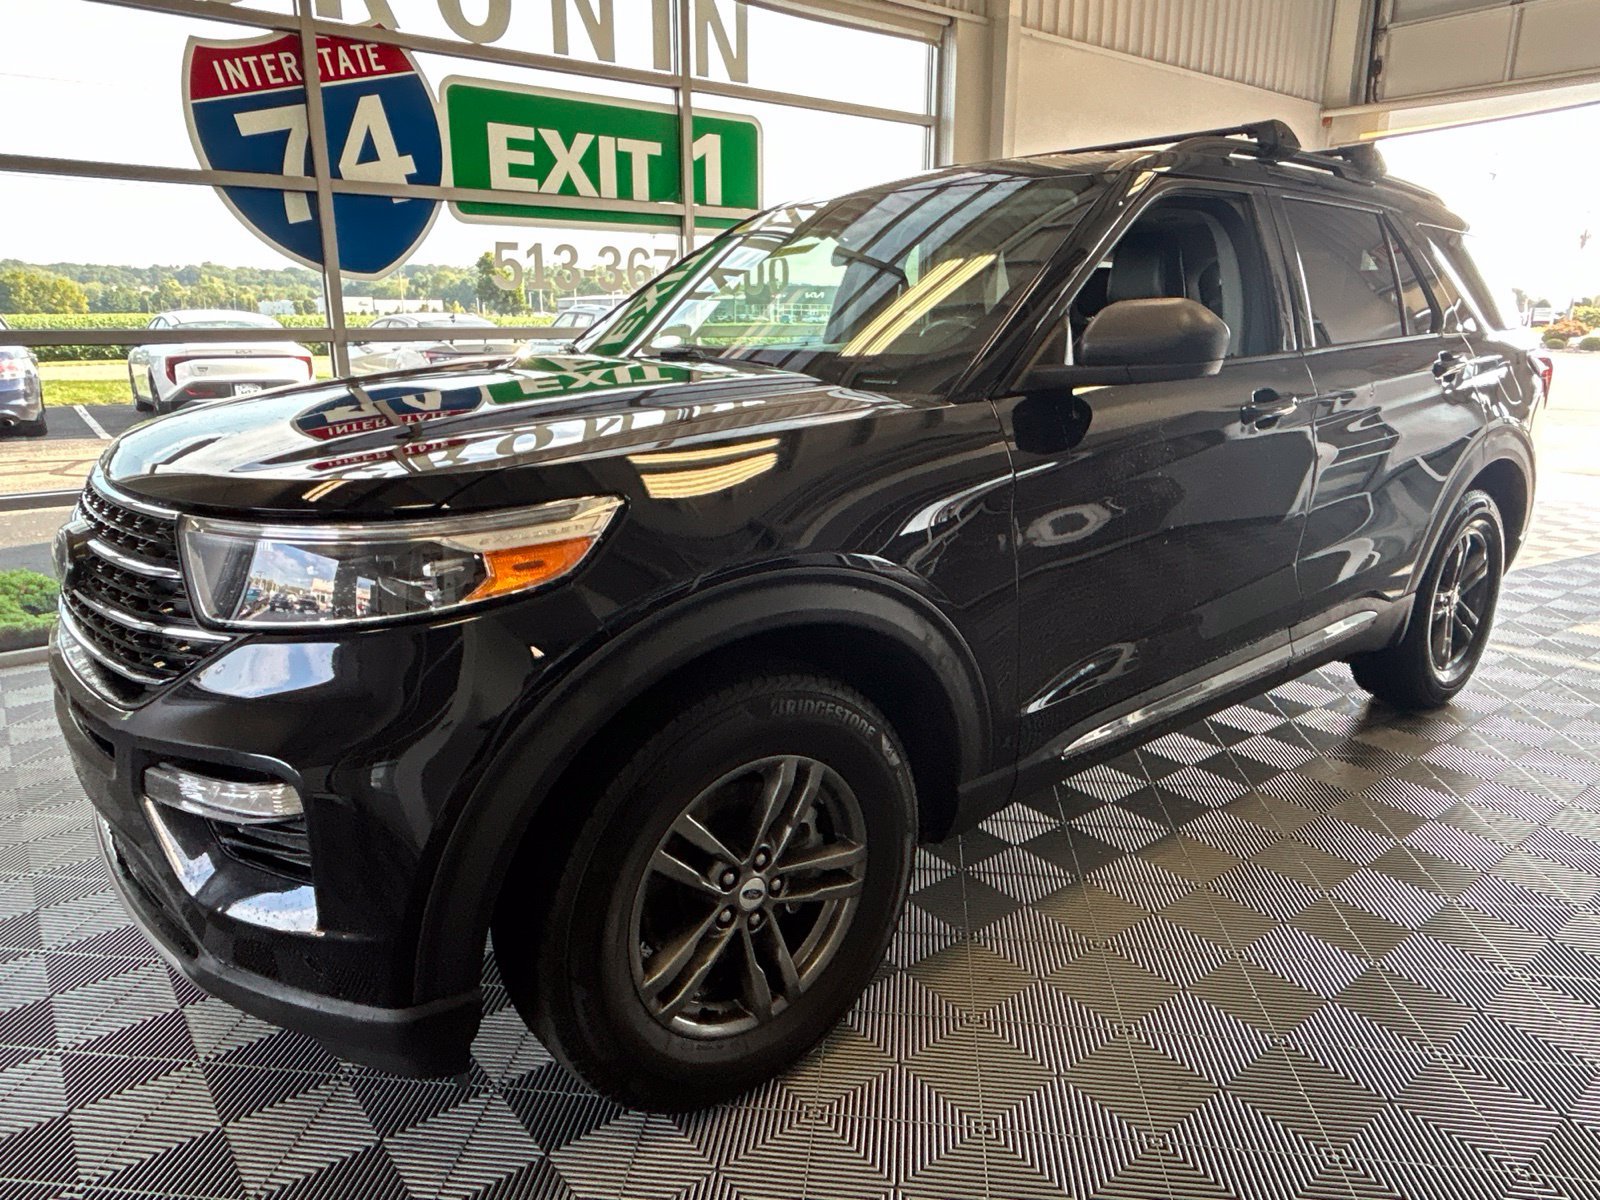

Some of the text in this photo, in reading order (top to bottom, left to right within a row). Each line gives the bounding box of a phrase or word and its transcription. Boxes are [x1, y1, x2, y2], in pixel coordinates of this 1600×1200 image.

[213, 43, 387, 91] INTERTATE
[233, 94, 418, 225] 74
[486, 121, 723, 206] EXIT 1
[770, 698, 876, 739] BRIDGESTONE
